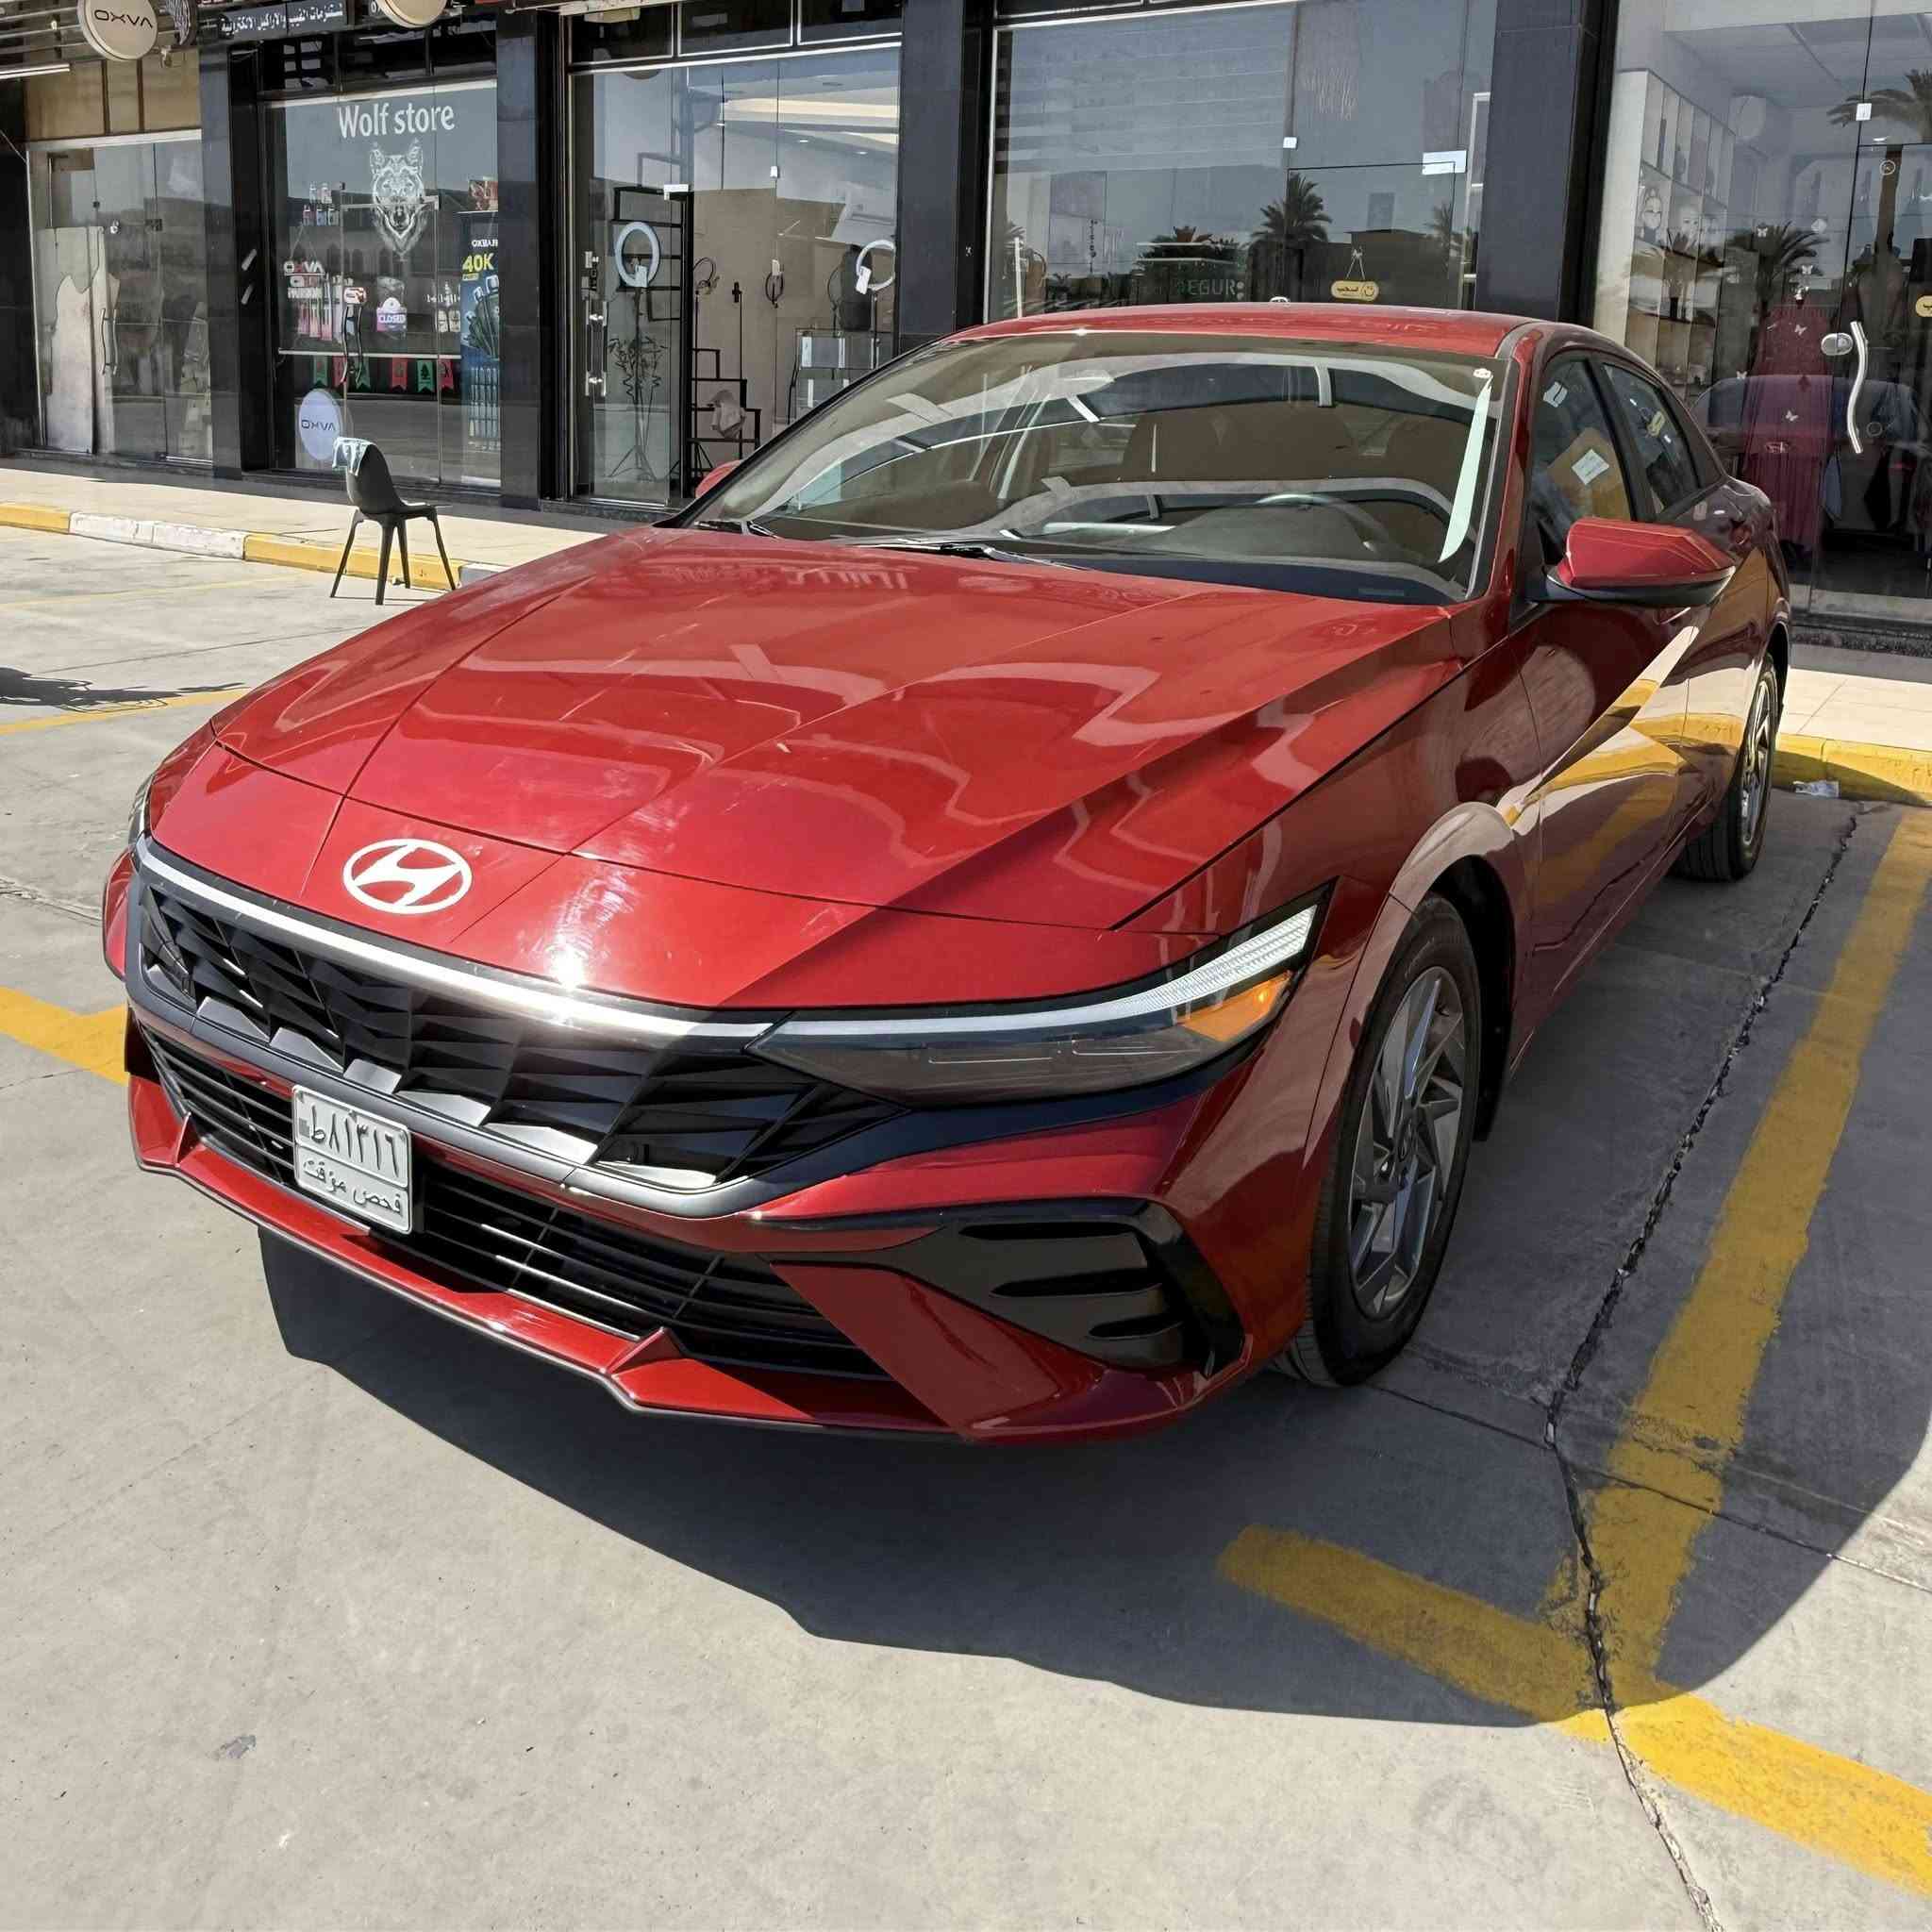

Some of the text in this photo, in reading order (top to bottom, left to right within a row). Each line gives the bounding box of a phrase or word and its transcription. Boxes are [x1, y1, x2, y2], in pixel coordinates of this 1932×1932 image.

[94, 9, 153, 28] OXVA
[338, 102, 456, 139] Wolf store
[462, 252, 494, 273] 40K
[301, 419, 336, 431] OXVA
[353, 1188, 403, 1218] فحص
